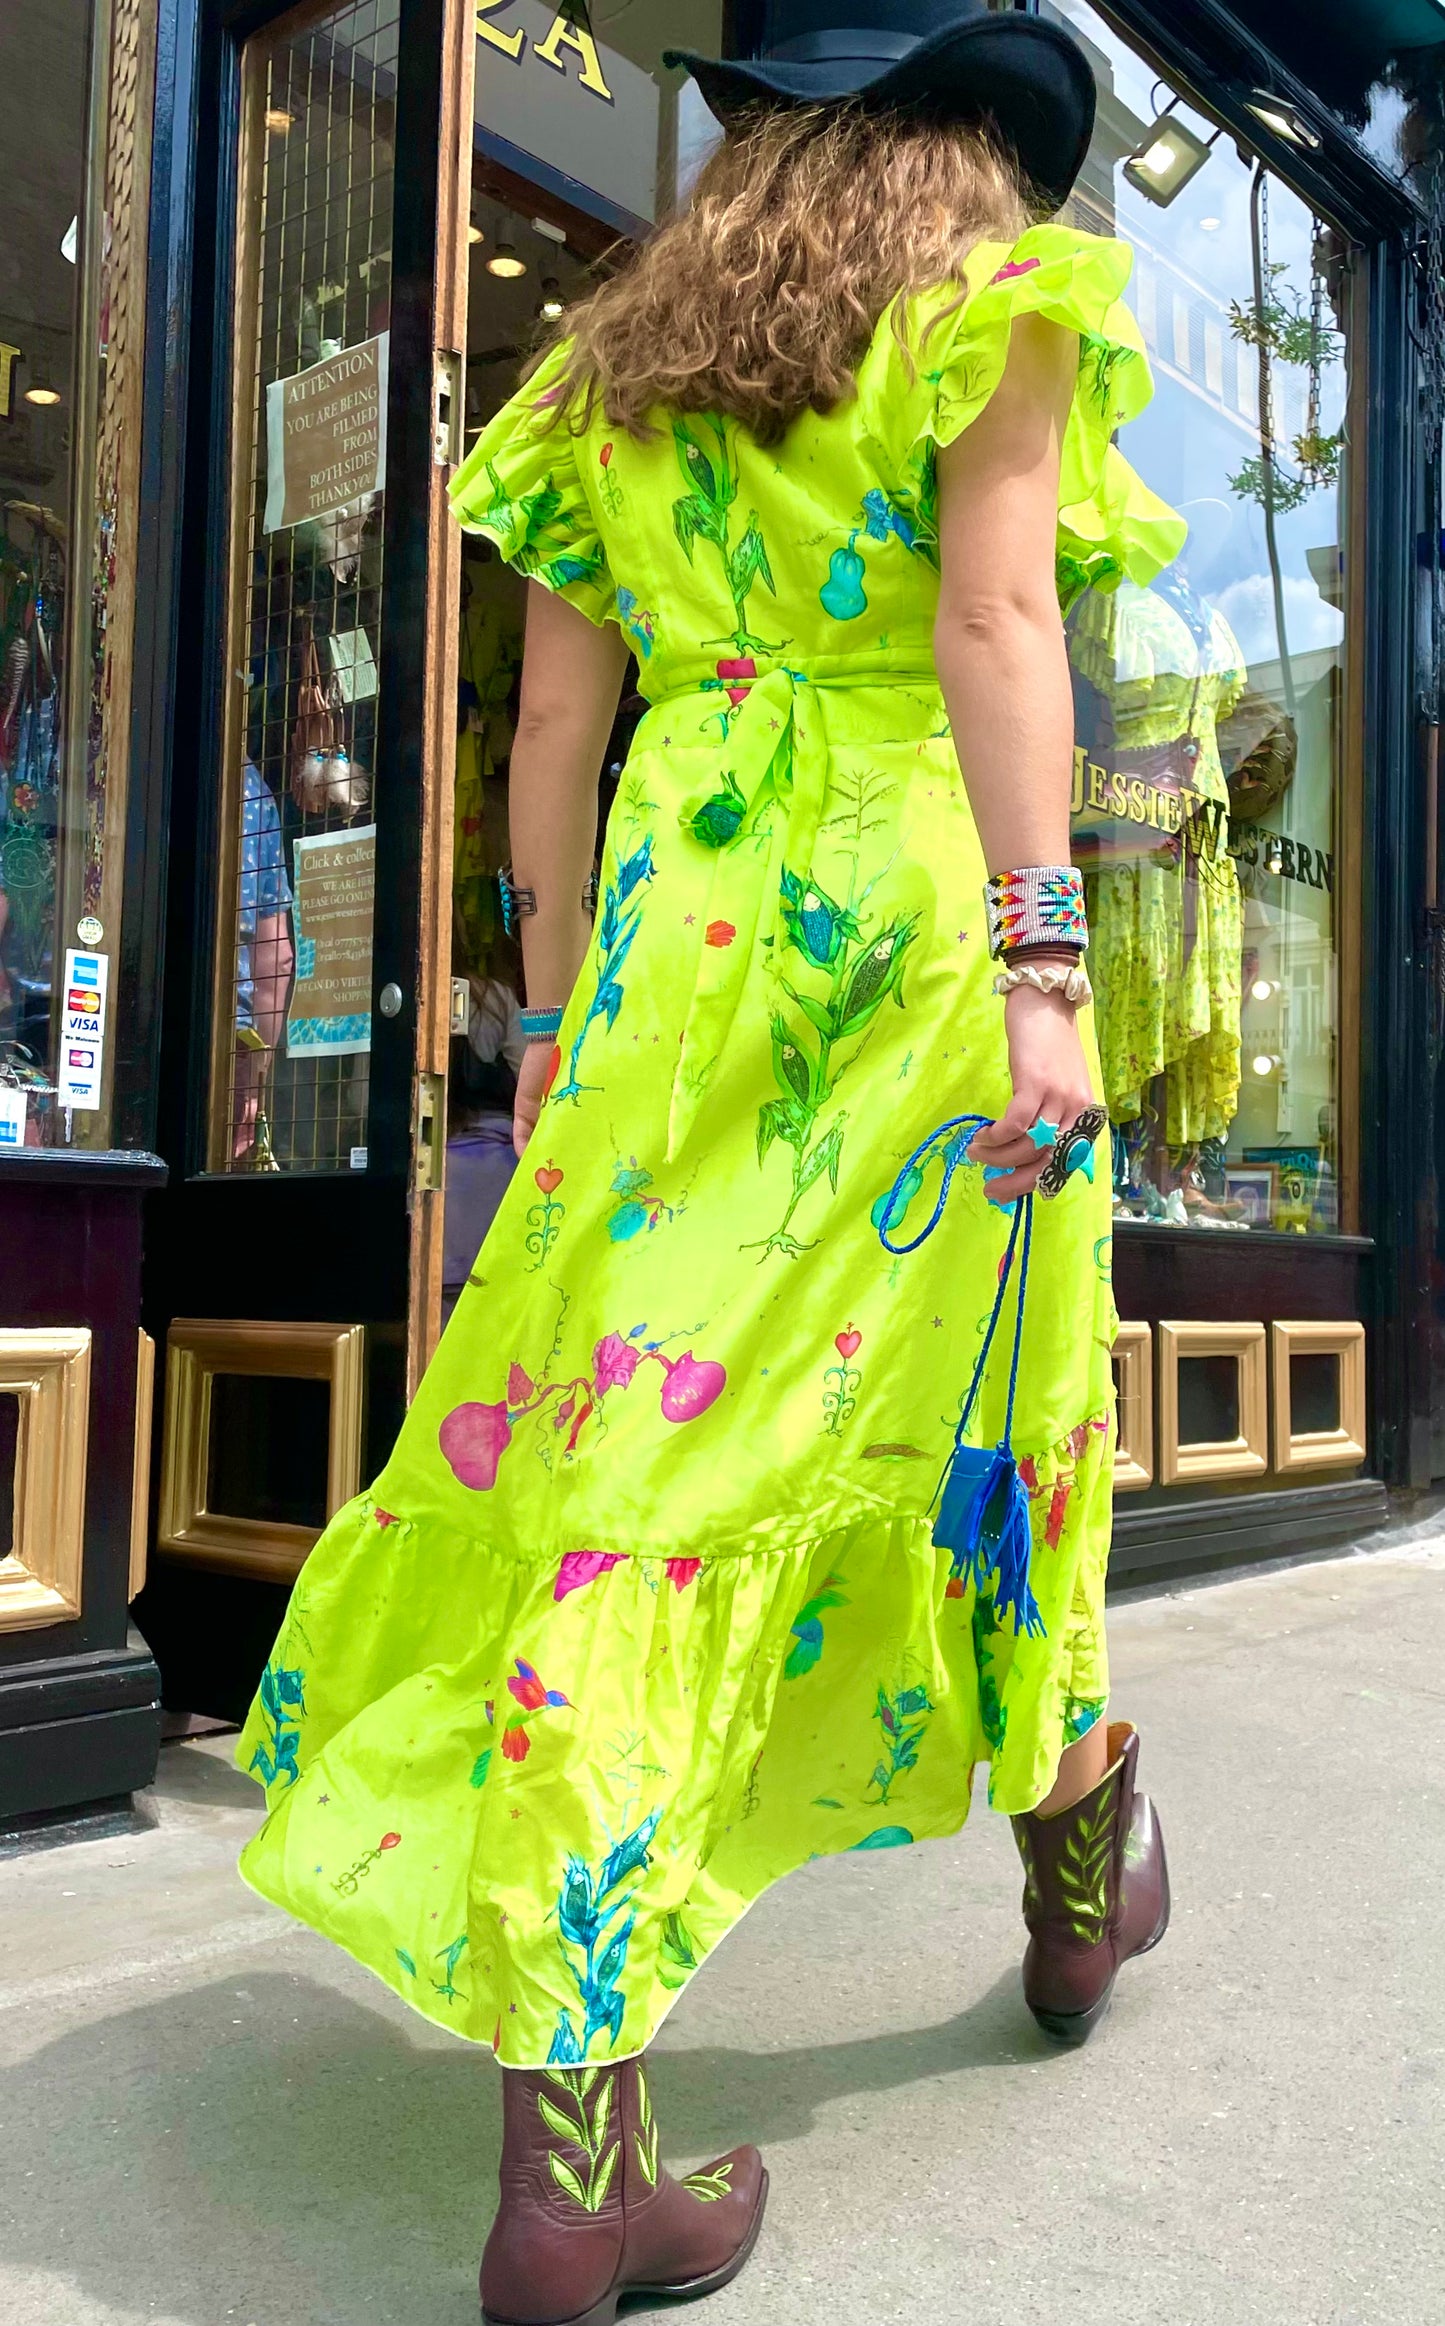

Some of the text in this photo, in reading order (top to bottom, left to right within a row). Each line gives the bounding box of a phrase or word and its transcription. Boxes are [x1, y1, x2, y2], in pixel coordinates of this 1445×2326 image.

[287, 348, 374, 404] ATTENTION
[286, 384, 377, 435] YOU ARE BEING
[332, 406, 378, 438] FILMED
[343, 427, 377, 454] FROM
[310, 449, 377, 489] BOTH SIDES
[1071, 745, 1183, 834] JESSIE
[304, 848, 375, 871] Click & collect
[322, 874, 374, 891] WE ARE HER
[302, 889, 374, 910] PLEASE GO ONLIN
[325, 978, 339, 990] DO
[342, 975, 372, 988] VIRTU
[333, 990, 372, 1003] SHOPPIN
[69, 1017, 99, 1032] VISA
[72, 1087, 89, 1095] VISA
